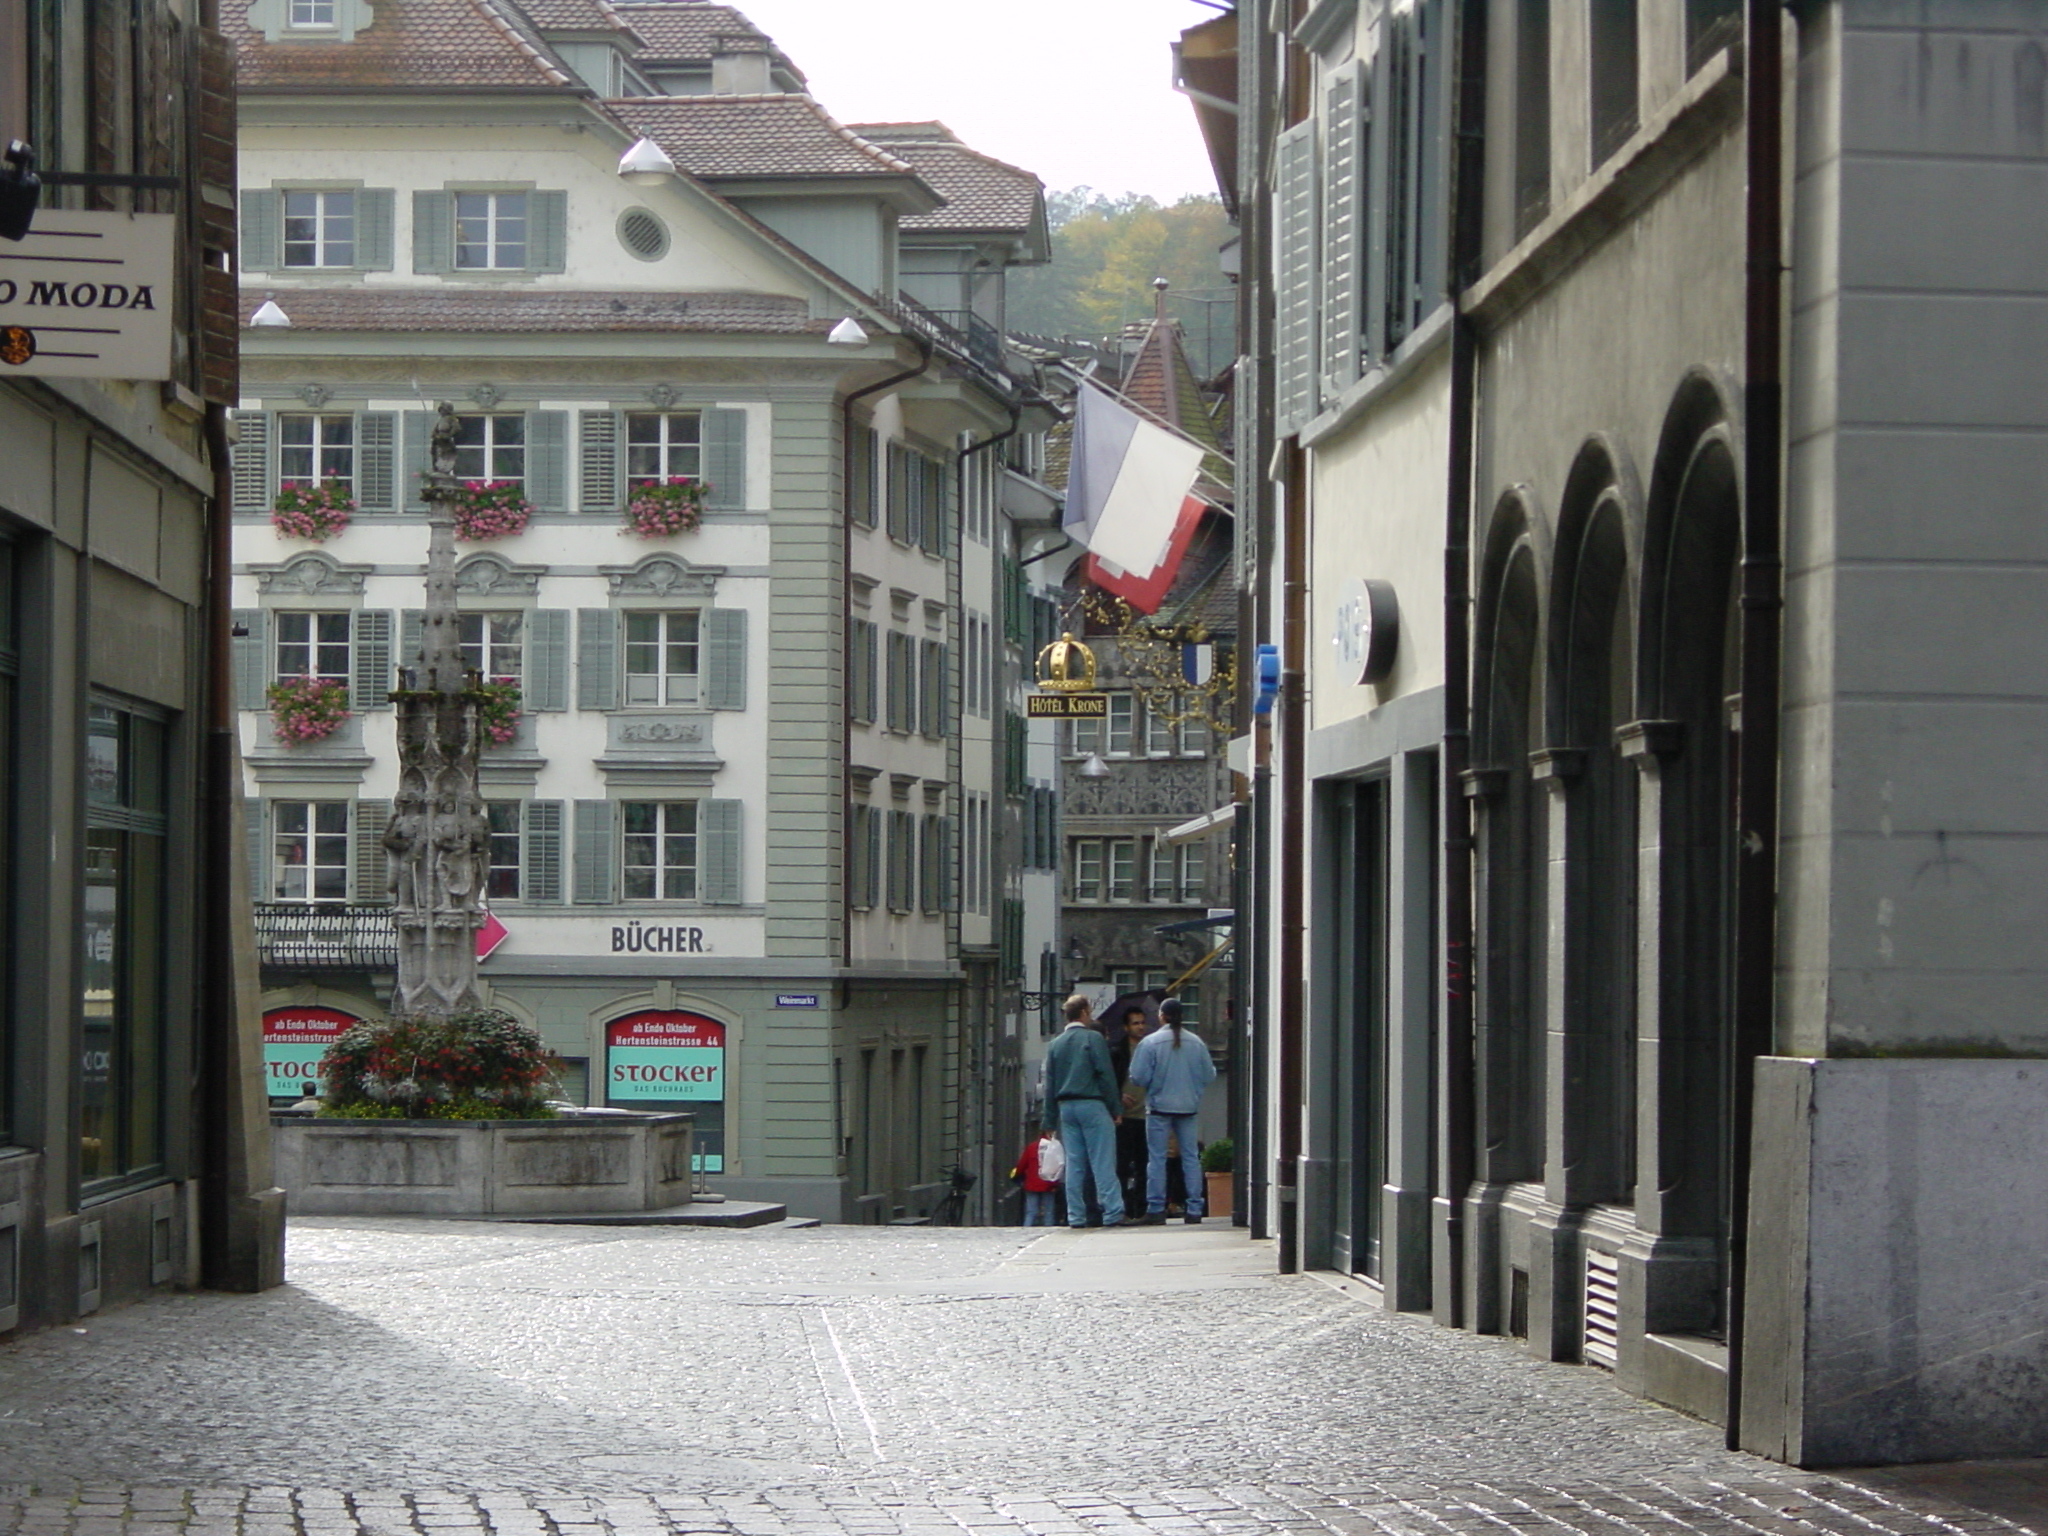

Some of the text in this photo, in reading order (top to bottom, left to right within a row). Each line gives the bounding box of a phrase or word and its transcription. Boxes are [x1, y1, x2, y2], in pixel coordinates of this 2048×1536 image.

[25, 281, 156, 311] MODA
[1068, 698, 1104, 713] KRONE
[612, 920, 704, 953] BÜCHER
[274, 1020, 338, 1030] ab Ende Oktober
[633, 1023, 697, 1033] ab Ende Oktober
[263, 1032, 338, 1043] ertensteinstrass
[616, 1035, 719, 1046] Hertensteinstrasse 44
